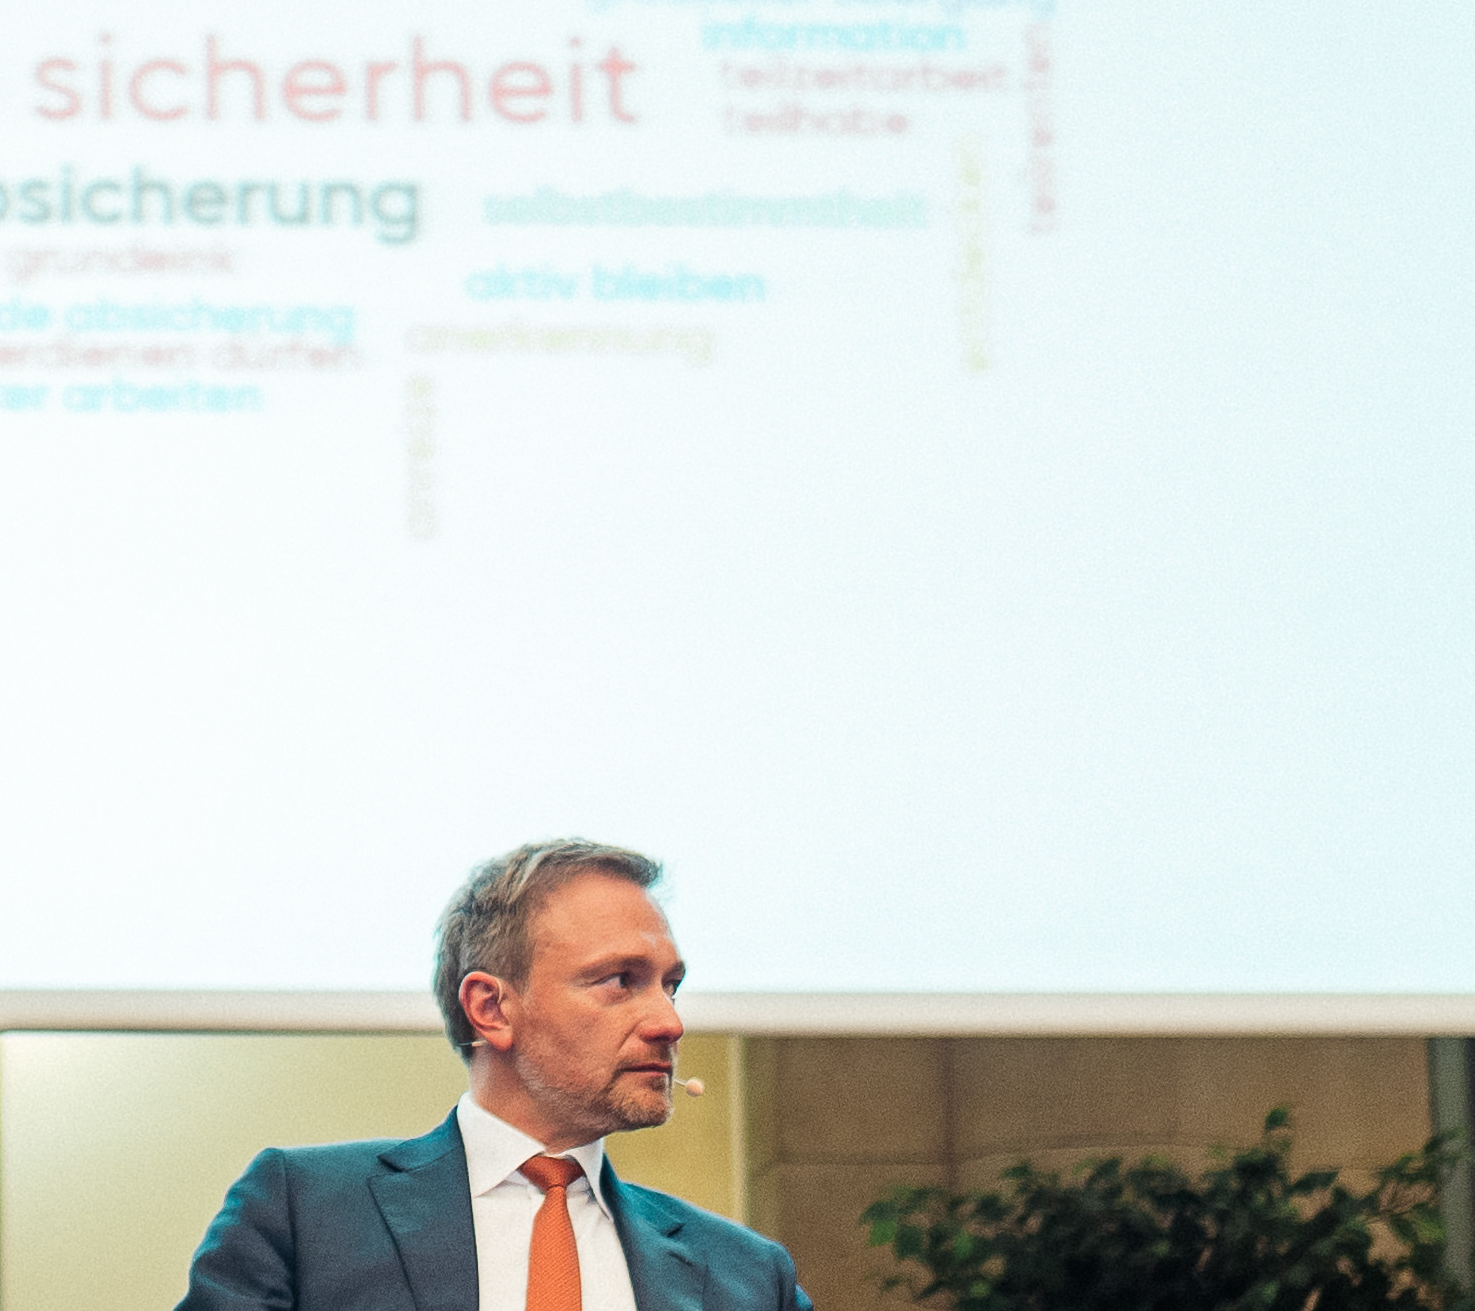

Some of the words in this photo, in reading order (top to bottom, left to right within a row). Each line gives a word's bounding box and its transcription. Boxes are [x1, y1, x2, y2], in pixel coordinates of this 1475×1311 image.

[702, 15, 967, 55] information
[30, 29, 639, 129] sicherheit
[722, 102, 910, 137] teilhabe
[464, 257, 581, 303] aktiv
[589, 260, 768, 304] bleiben
[60, 295, 356, 344] absicherung
[60, 380, 264, 415] arbeiten
